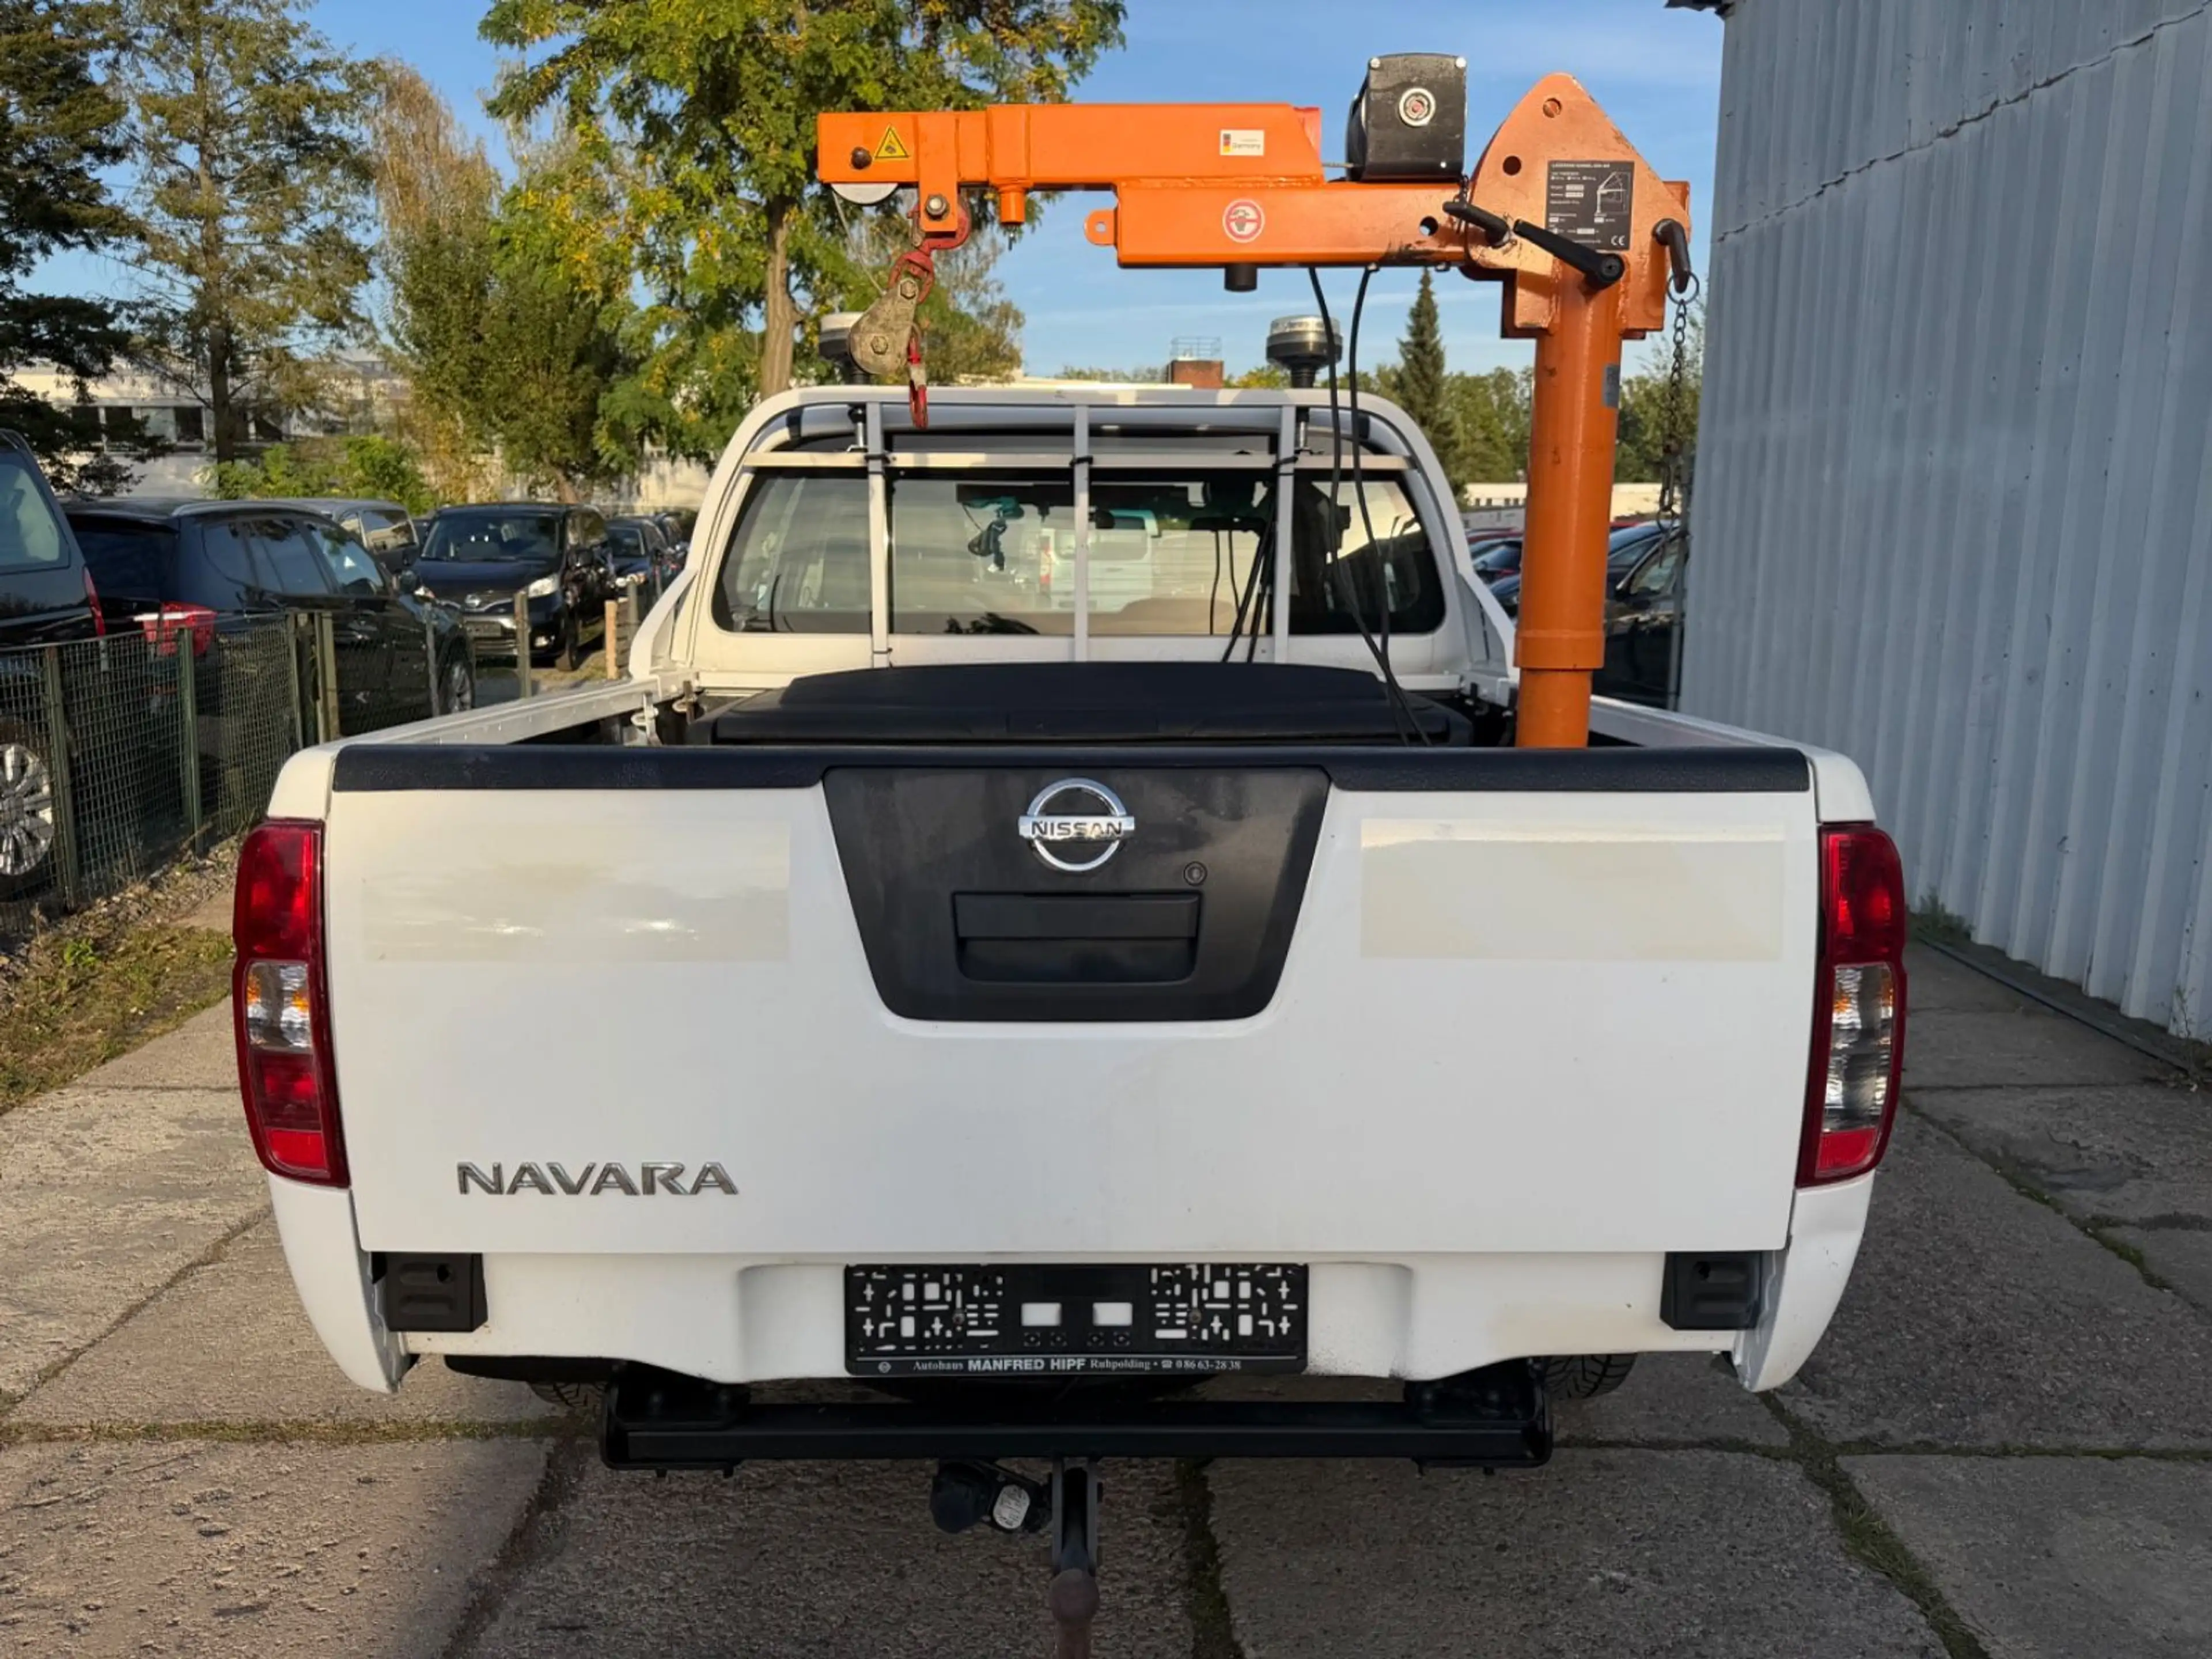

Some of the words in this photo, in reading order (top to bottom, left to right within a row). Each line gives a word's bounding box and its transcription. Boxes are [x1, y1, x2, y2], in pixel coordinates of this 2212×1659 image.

[1031, 821, 1122, 836] NISSAN
[457, 1162, 738, 1196] NAVARA
[913, 1361, 964, 1371] Autohaus
[968, 1359, 1045, 1372] MANFRED
[1050, 1358, 1086, 1370] HIPF
[1090, 1358, 1150, 1371] Ruhpolding
